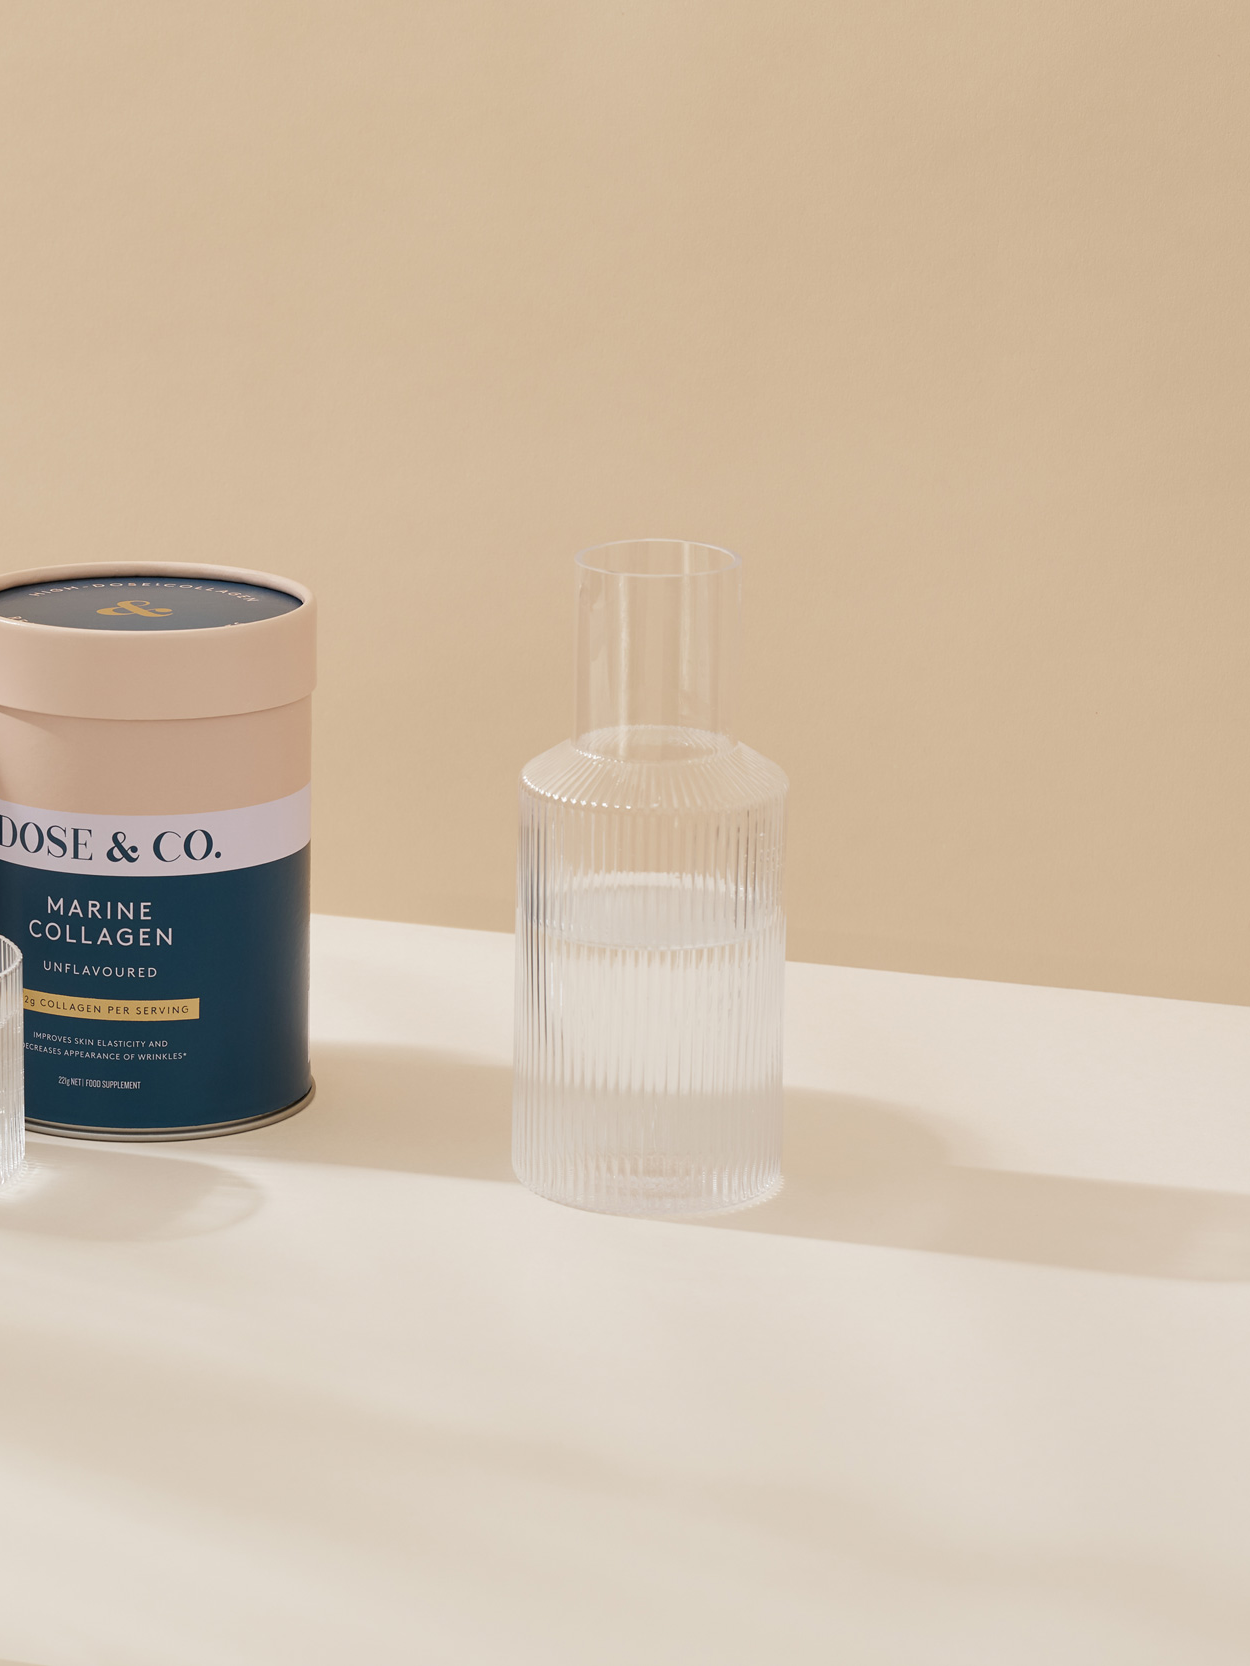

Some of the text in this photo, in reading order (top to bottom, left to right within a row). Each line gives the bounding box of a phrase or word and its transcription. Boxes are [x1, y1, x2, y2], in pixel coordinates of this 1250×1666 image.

[96, 600, 173, 617] &
[106, 831, 140, 863] &
[152, 829, 222, 862] CO.
[47, 896, 152, 920] MARINE
[28, 919, 173, 946] COLLAGEN
[43, 960, 157, 978] UNFLAVOURED
[24, 995, 189, 1015] 2g COLLAGEN PER SERVING
[33, 1031, 168, 1048] IMPROVES SKIN ELASTICITY AND
[64, 1049, 120, 1060] APPEARANCE
[123, 1053, 135, 1061] OF
[85, 1079, 101, 1088] FOOD
[102, 1080, 141, 1089] SUPPLEMENT
